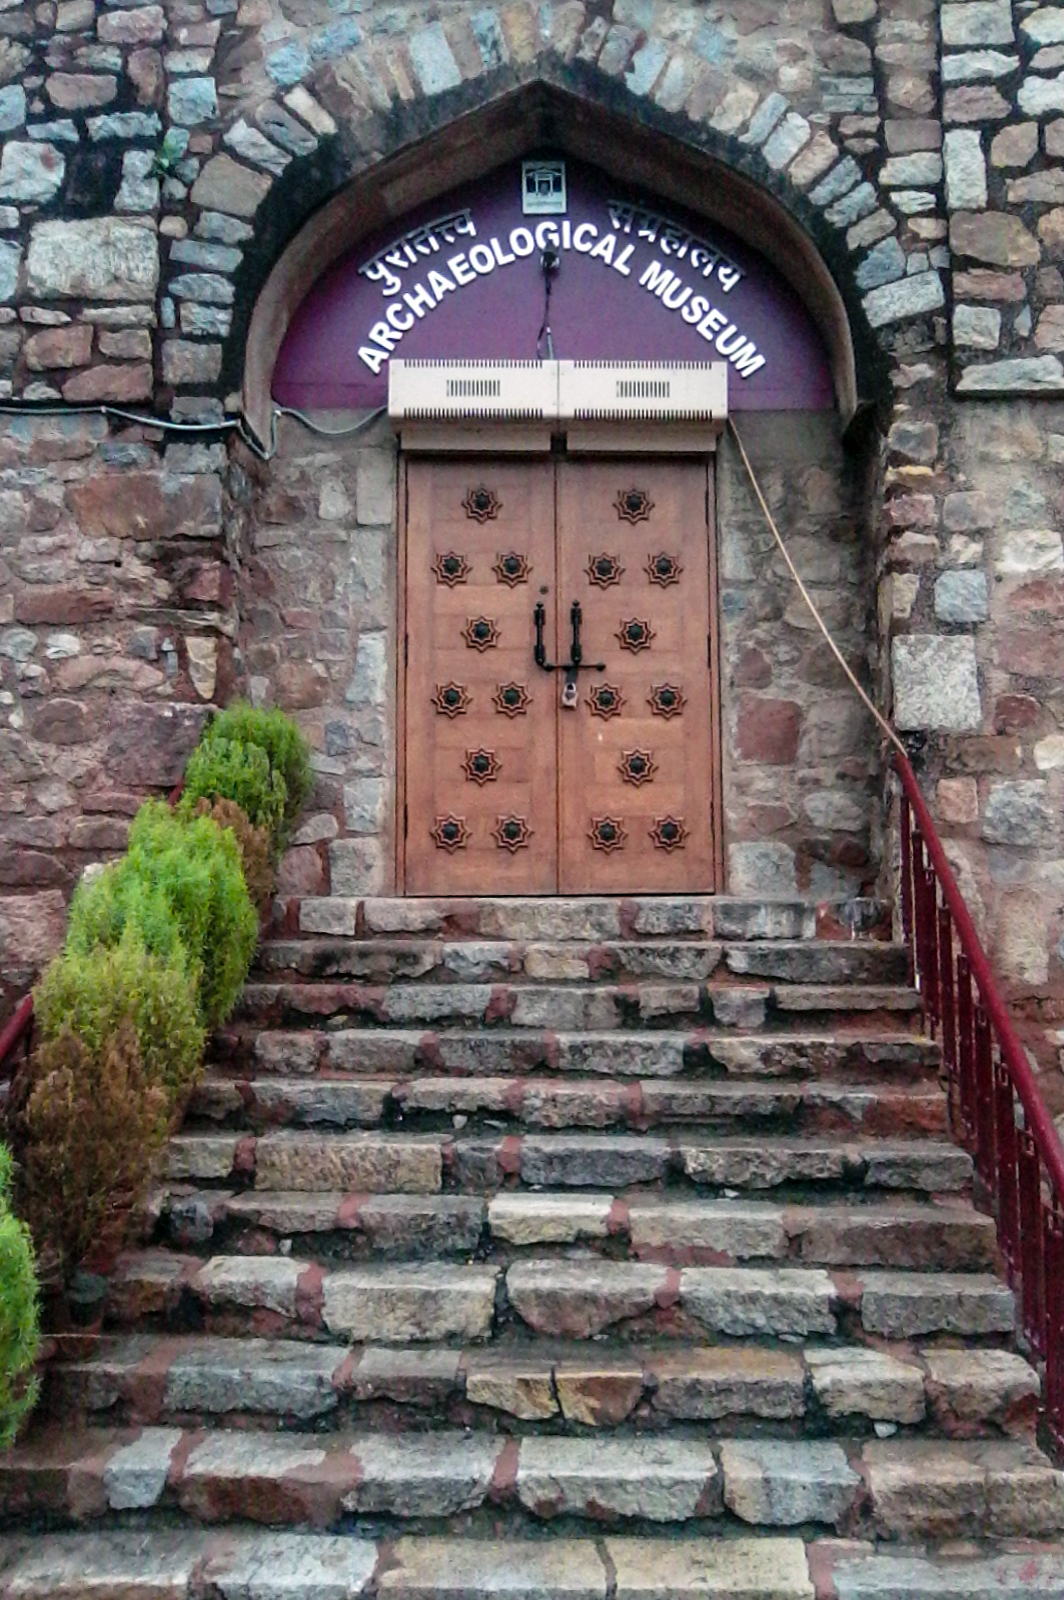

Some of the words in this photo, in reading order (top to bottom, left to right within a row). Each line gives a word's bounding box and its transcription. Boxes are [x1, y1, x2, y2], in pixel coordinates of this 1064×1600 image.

[357, 220, 635, 374] ARCHAEOLOGICAL
[638, 260, 766, 378] MUSEUM
[607, 199, 746, 292] संग्रहालय
